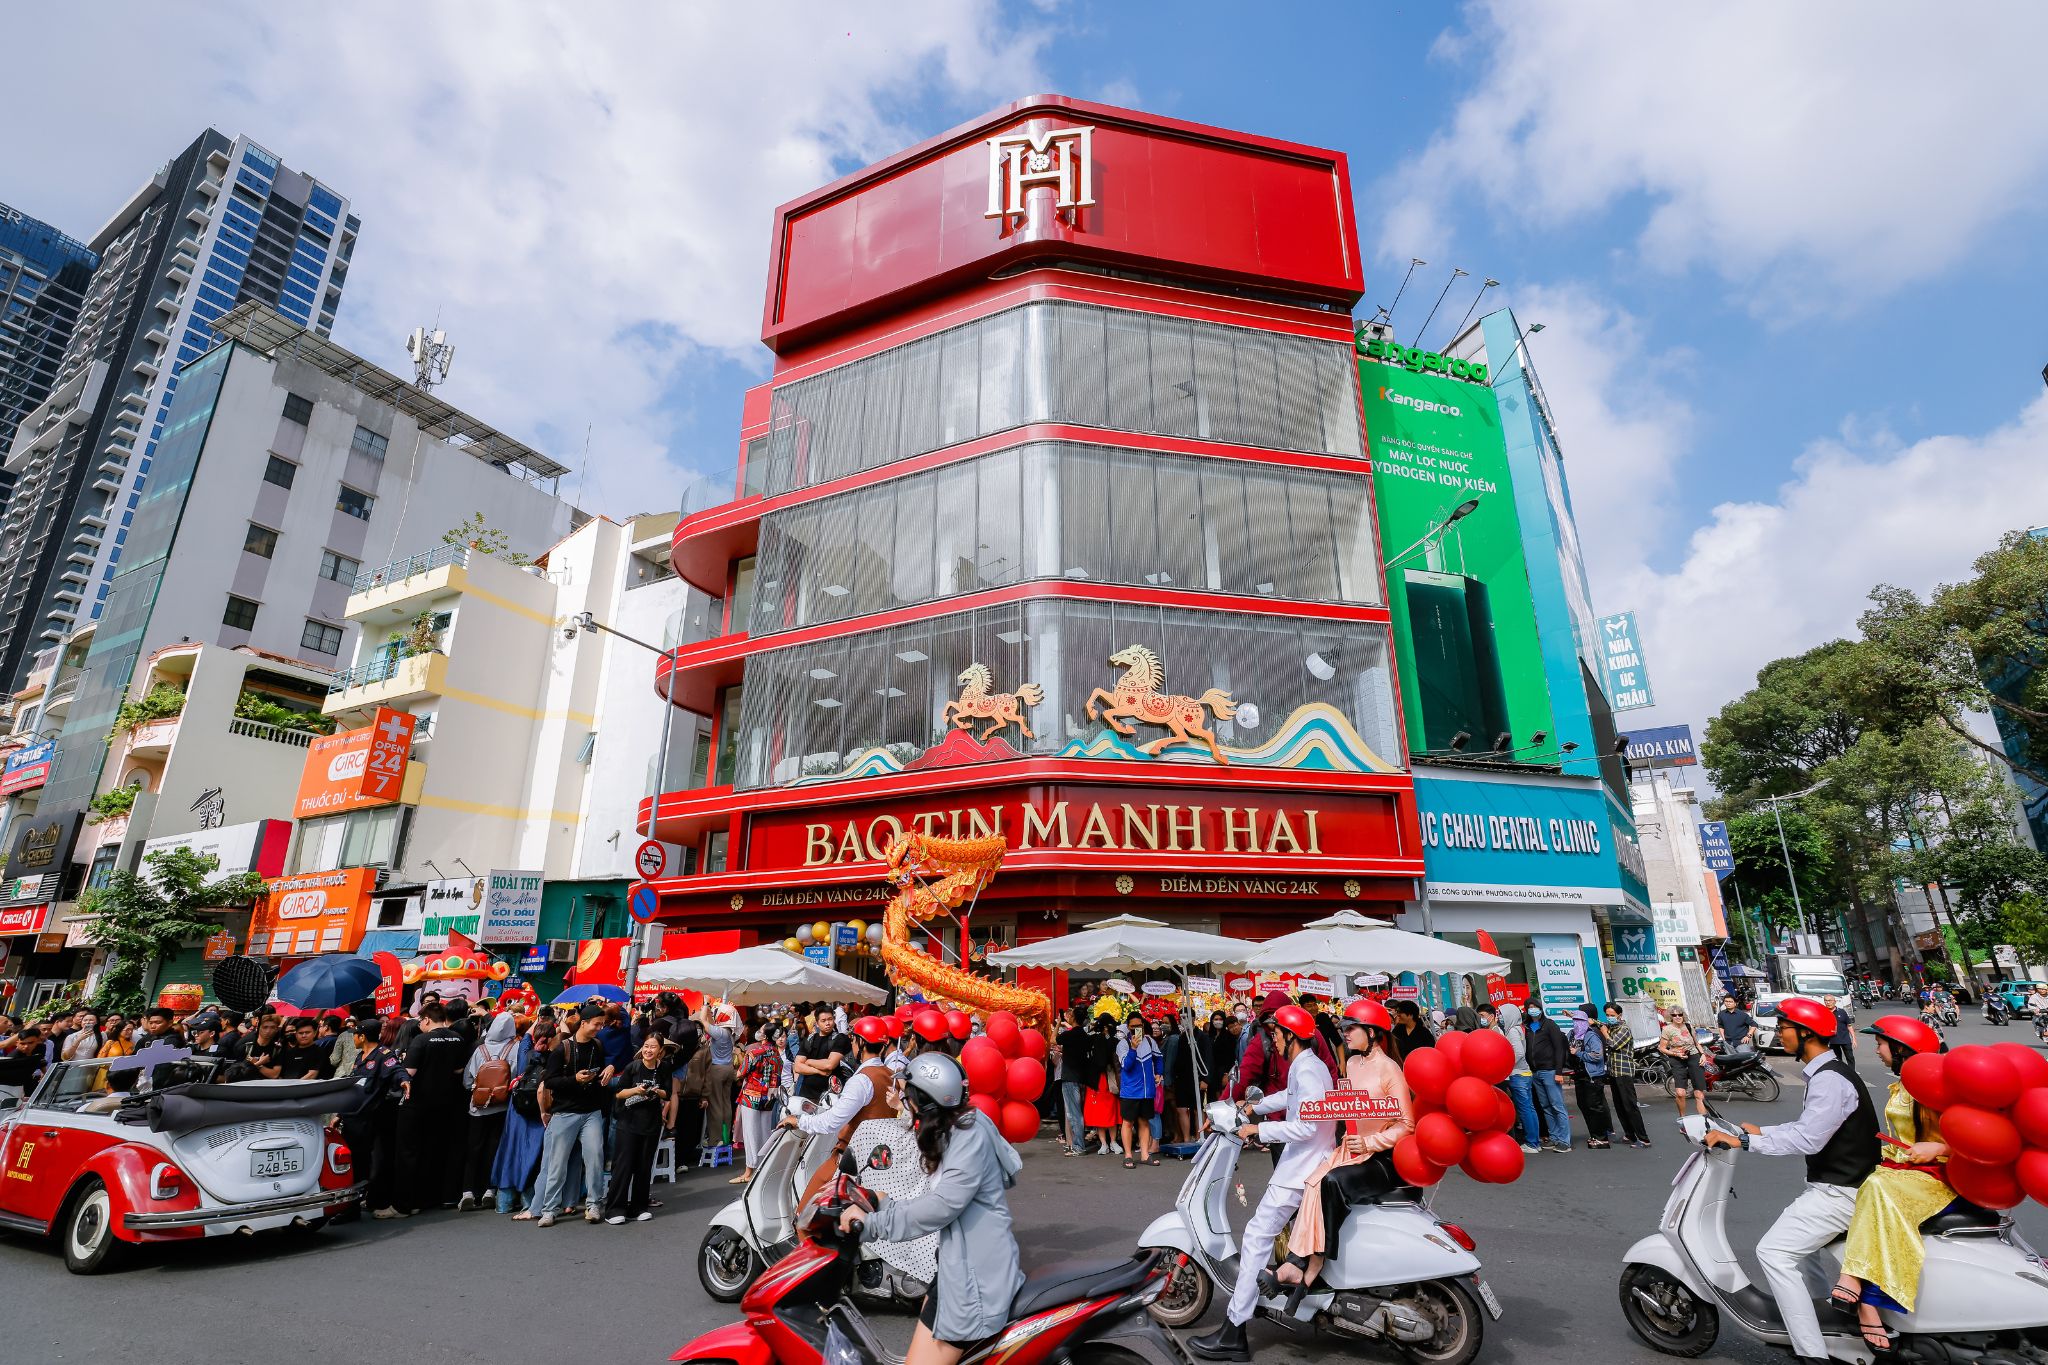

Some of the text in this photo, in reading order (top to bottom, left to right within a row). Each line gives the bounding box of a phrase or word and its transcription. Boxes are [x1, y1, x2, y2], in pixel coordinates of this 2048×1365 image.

[1354, 330, 1488, 382] Kangaroo
[1379, 386, 1461, 417] Kangaroo
[1438, 473, 1462, 488] ION
[1608, 652, 1640, 671] KHOA
[1619, 671, 1636, 687] ÚC
[1616, 688, 1648, 708] CHÂU
[356, 732, 373, 742] CIRC
[375, 741, 405, 754] OPEN
[1626, 738, 1692, 760] KHOA KIM
[370, 750, 401, 772] 24
[375, 775, 389, 793] 7
[301, 790, 331, 810] THUỐC
[1019, 801, 1206, 851] MANH
[1221, 806, 1323, 855] HAI
[1442, 812, 1486, 849] CHAU
[1489, 815, 1549, 852] DENTAL
[1550, 818, 1601, 854] CLINIC
[1706, 839, 1725, 848] NHA
[1706, 848, 1730, 858] KHOA
[1711, 859, 1729, 868] KIM
[492, 873, 541, 890] HOÀI THY
[1160, 874, 1320, 895] ĐIỂM ĐẾN VÀNG 24K
[282, 894, 319, 915] CIRCA
[762, 886, 890, 906] ĐIỂM ĐẾN VÀNG 24K
[2, 913, 23, 924] CIRCLE
[454, 915, 480, 935] BEAUTY
[1540, 959, 1575, 967] UC CHAU
[1659, 951, 1670, 961] ÂY
[1300, 1097, 1399, 1112] A36 NGUYỄN TRÃI
[267, 1151, 288, 1161] 51L
[257, 1161, 298, 1174] 248.56
